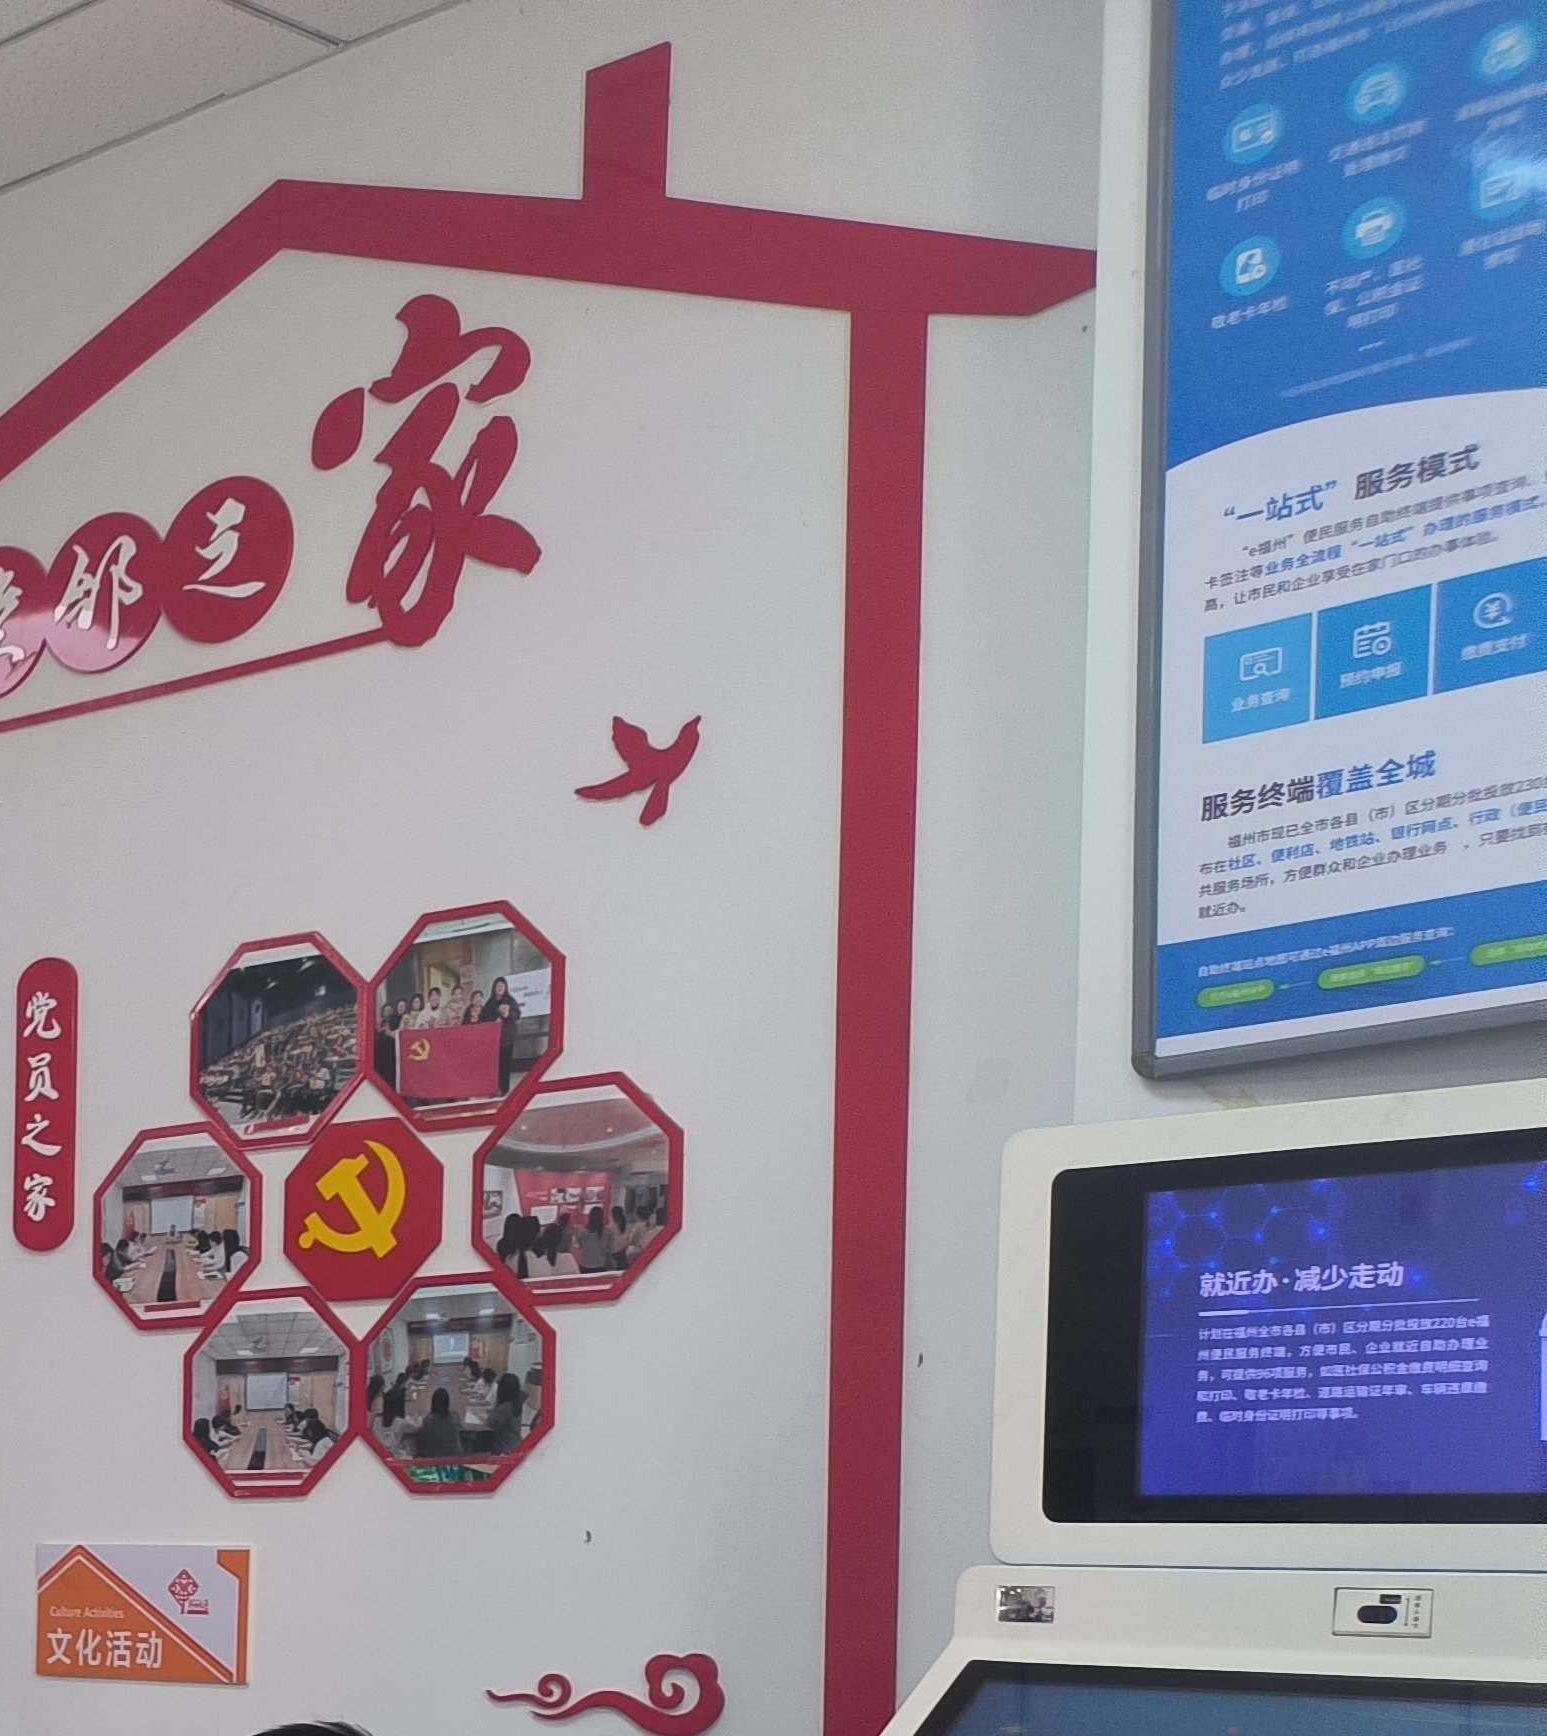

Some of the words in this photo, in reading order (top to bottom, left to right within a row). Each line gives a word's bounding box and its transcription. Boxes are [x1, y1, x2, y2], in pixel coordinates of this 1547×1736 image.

[1354, 443, 1480, 501] 服务模式
[1201, 750, 1437, 822] 服务终端覆盖全城
[21, 993, 62, 1223] 党员之家
[1199, 1261, 1404, 1297] 就近办·减少走动
[50, 1606, 81, 1618] Culture
[83, 1607, 124, 1619] Activities
[47, 1628, 163, 1669] 文化活动
